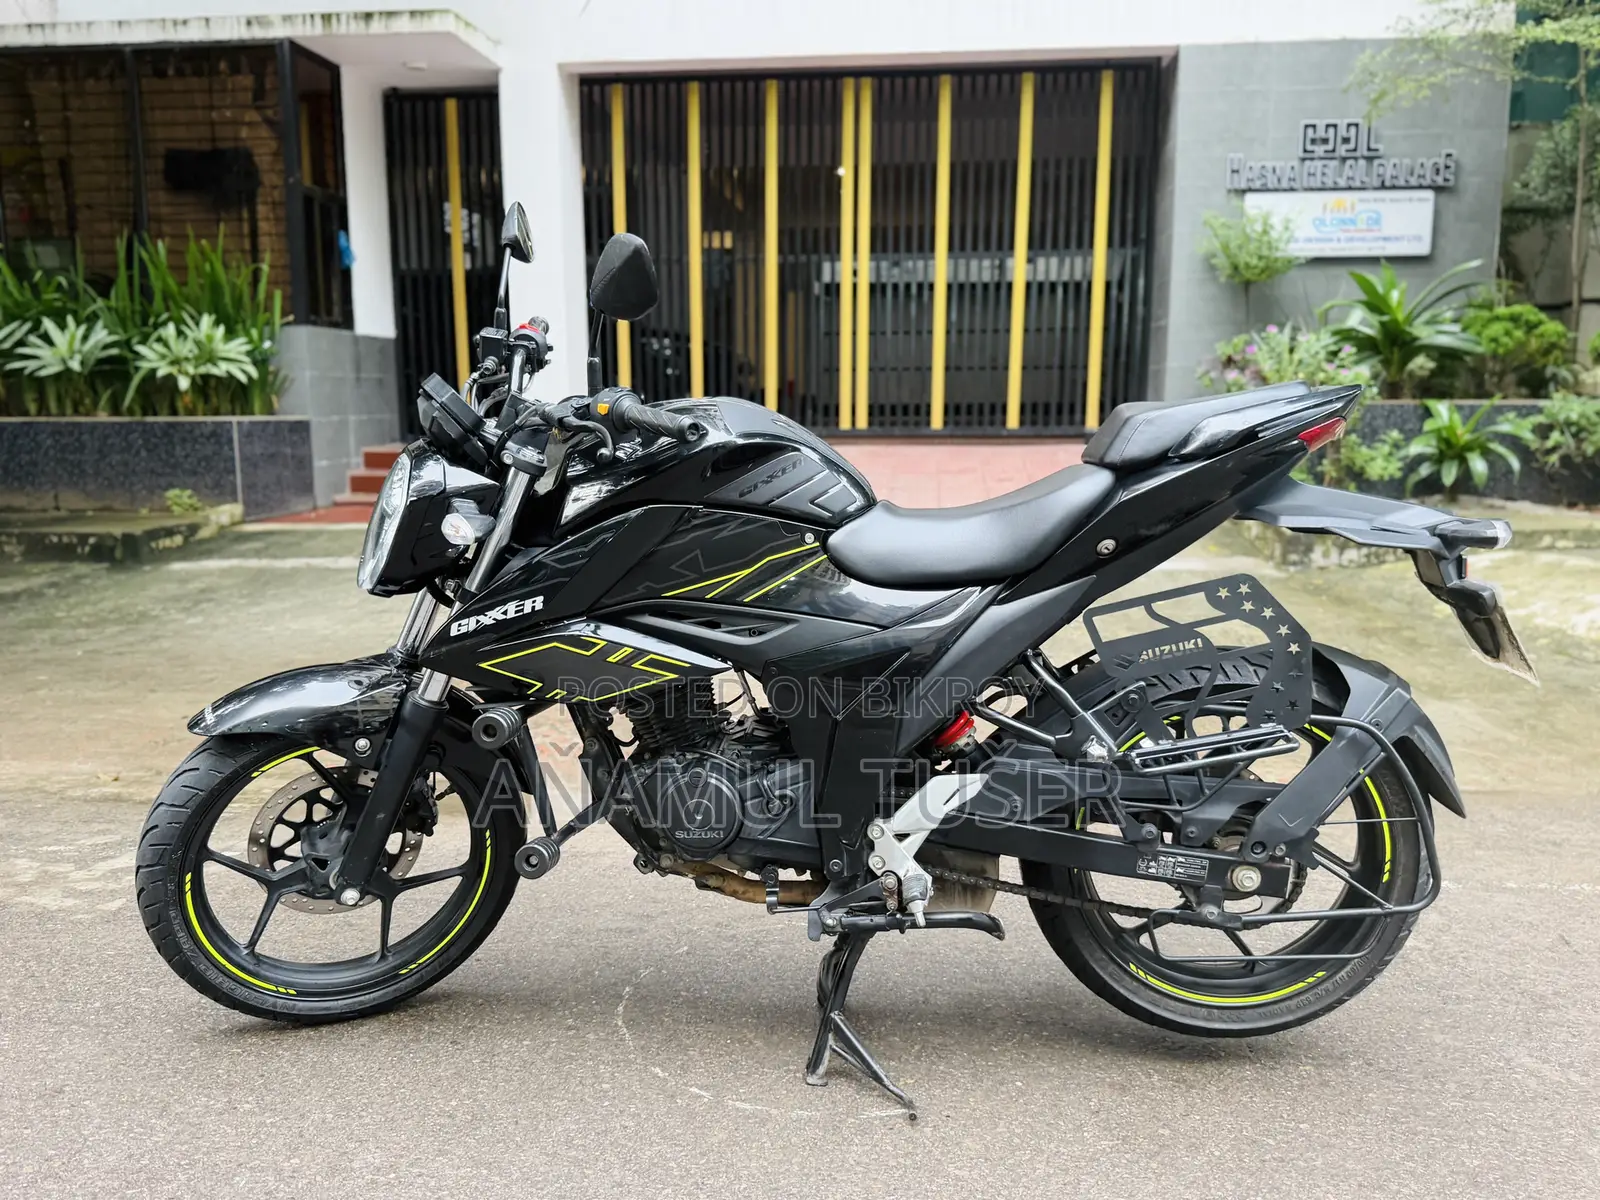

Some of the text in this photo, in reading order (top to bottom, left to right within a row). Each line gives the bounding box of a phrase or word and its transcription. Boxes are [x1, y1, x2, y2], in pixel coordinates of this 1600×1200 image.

[738, 456, 805, 499] GIXXER
[450, 595, 545, 637] GIXXER
[675, 830, 724, 839] SUZUKI
